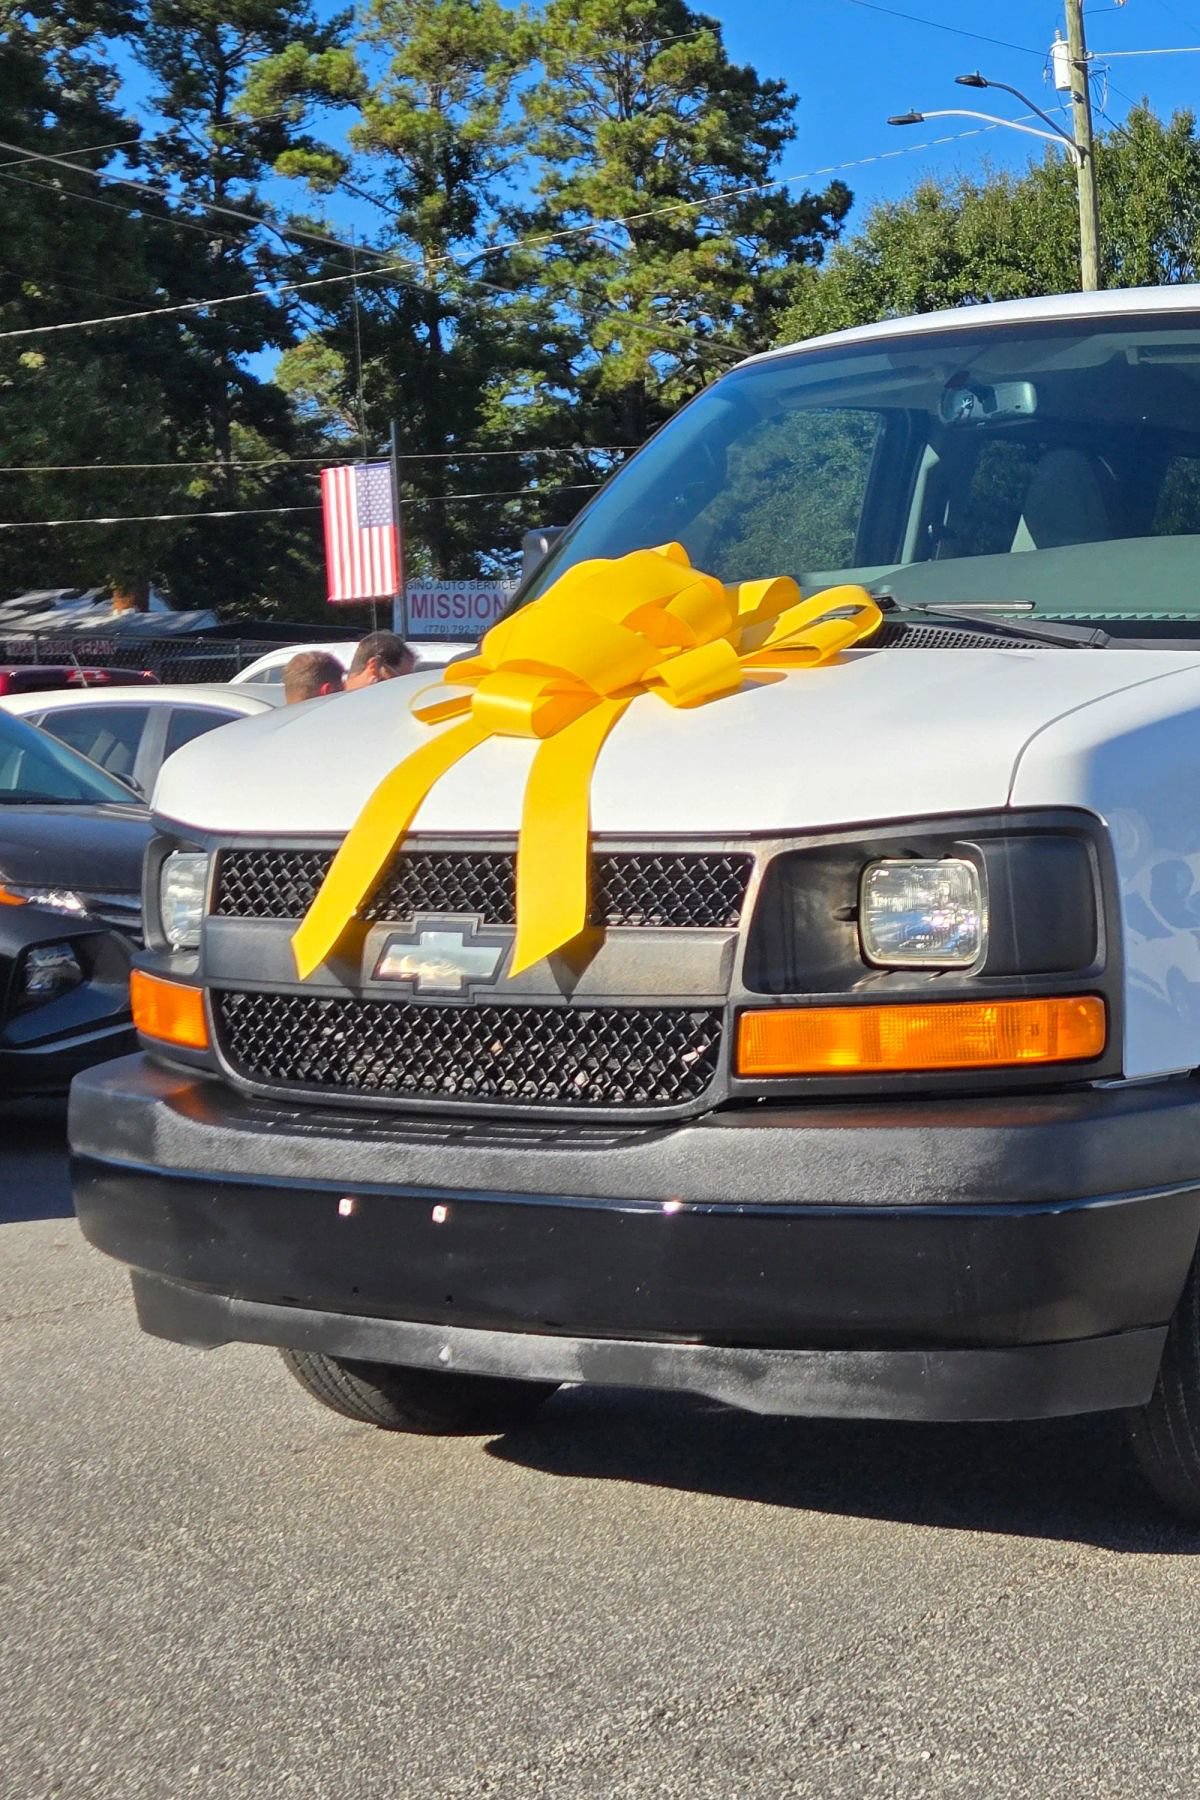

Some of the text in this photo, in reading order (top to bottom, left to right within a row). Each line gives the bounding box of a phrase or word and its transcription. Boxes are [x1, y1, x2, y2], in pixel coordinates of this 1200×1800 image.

[436, 581, 466, 591] AUTO
[469, 580, 517, 590] SERVICE
[411, 593, 509, 619] MISSION
